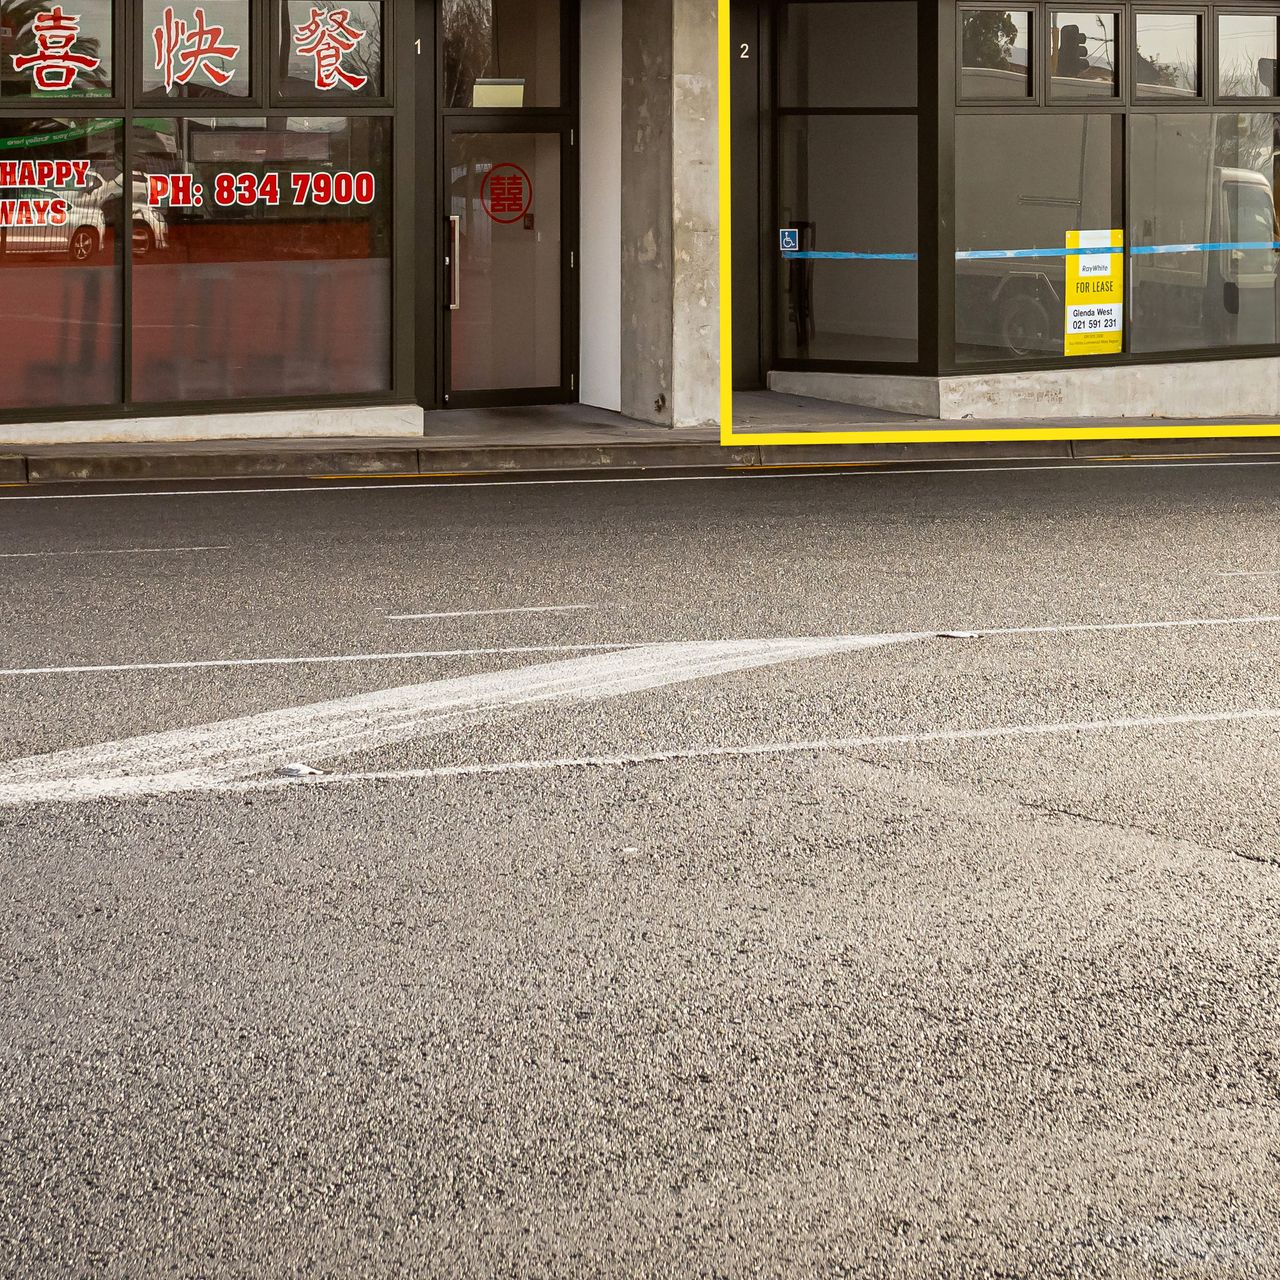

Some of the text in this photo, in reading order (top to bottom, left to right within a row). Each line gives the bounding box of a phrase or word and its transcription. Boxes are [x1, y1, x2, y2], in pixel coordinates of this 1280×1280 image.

[414, 38, 421, 55] 1
[740, 43, 750, 59] 2
[147, 171, 376, 207] PH: 834 7900
[1076, 280, 1114, 293] FOR LEASE
[1072, 308, 1113, 318] Glenda West
[1072, 318, 1117, 330] 021 591 231
